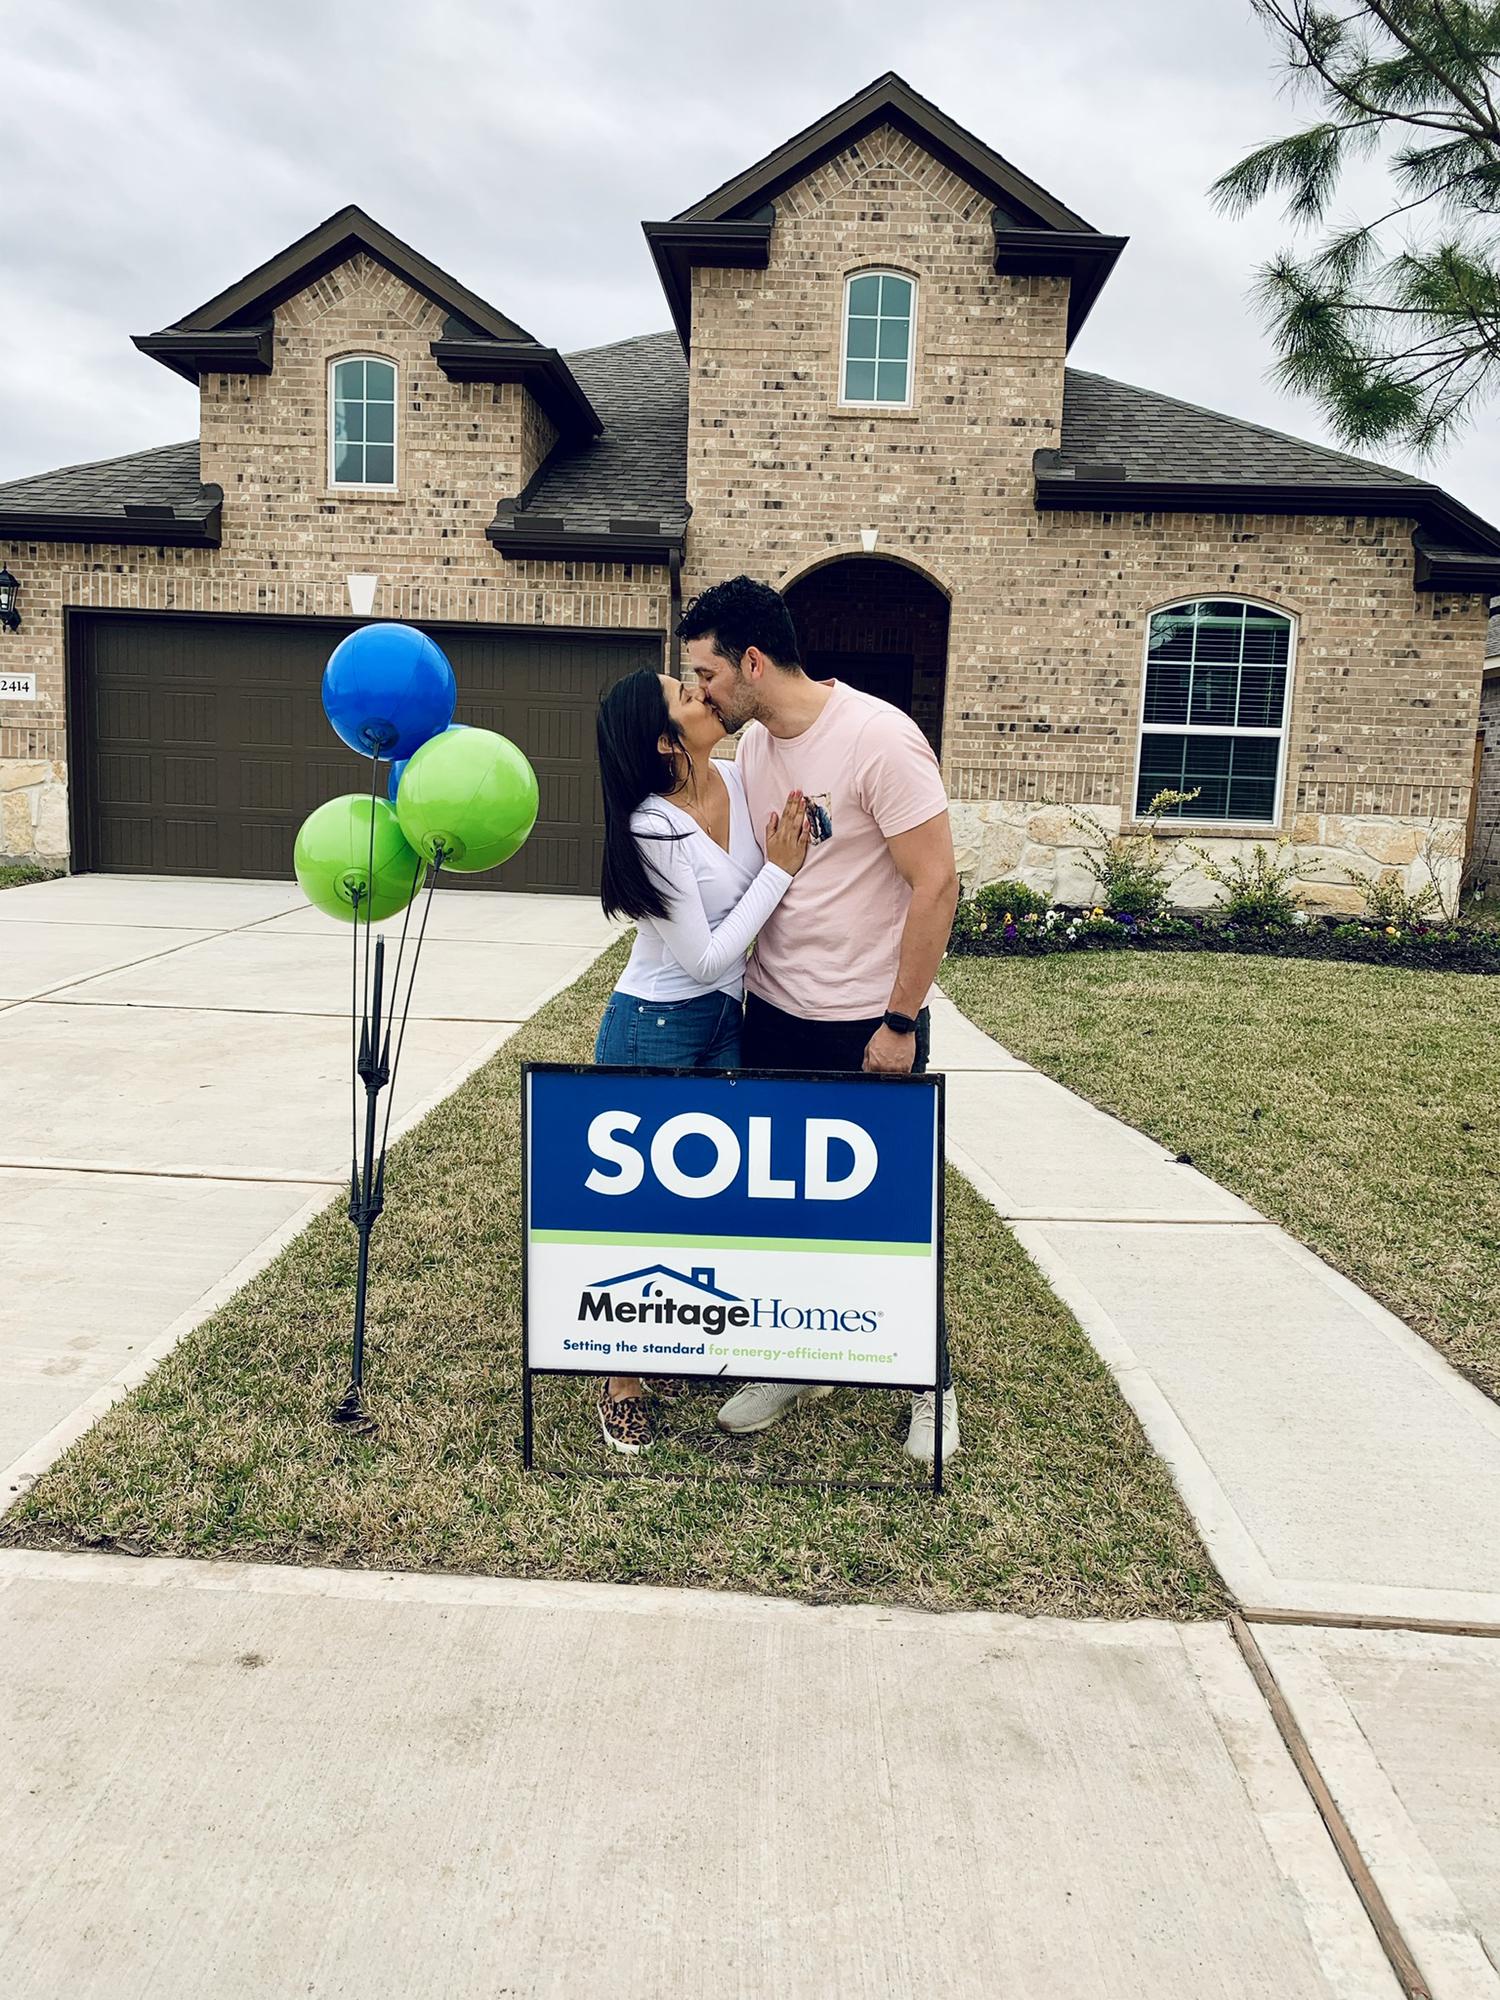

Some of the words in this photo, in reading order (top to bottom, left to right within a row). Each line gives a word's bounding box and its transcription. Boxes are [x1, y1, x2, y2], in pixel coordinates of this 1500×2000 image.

[0, 680, 30, 693] 2414
[584, 1110, 878, 1201] SOLD
[563, 1338, 612, 1355] Setting
[615, 1340, 638, 1353] the
[642, 1342, 705, 1356] standard
[708, 1343, 729, 1356] for
[732, 1347, 844, 1361] energy-efficient
